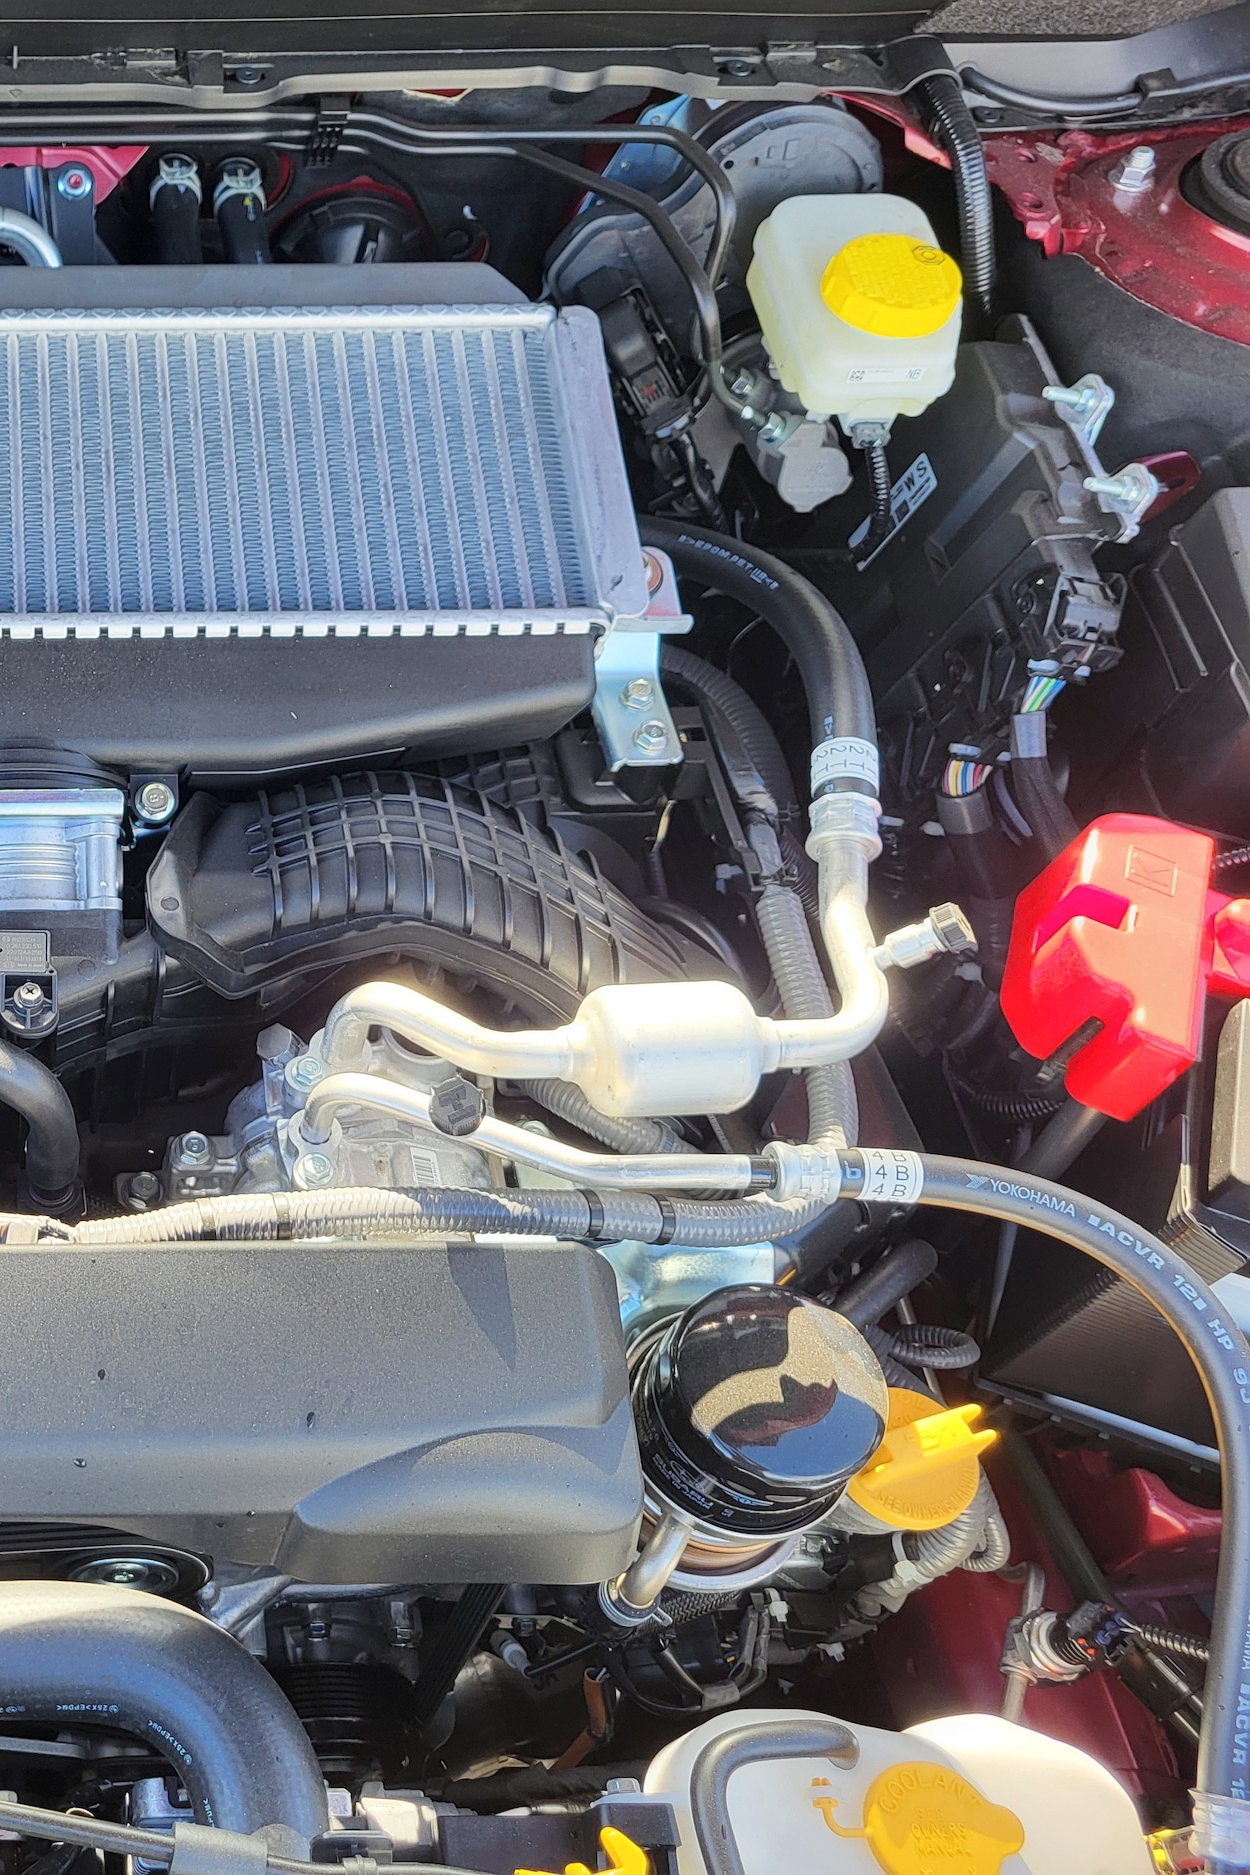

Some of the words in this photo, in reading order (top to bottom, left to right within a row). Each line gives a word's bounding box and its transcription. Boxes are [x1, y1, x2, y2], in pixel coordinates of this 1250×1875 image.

[990, 1179, 1076, 1218] YOKOHAMA
[1207, 1318, 1235, 1351] HP
[652, 1453, 714, 1505] SUBARU
[878, 1768, 982, 1813] COOLANT
[916, 1808, 942, 1822] SEE
